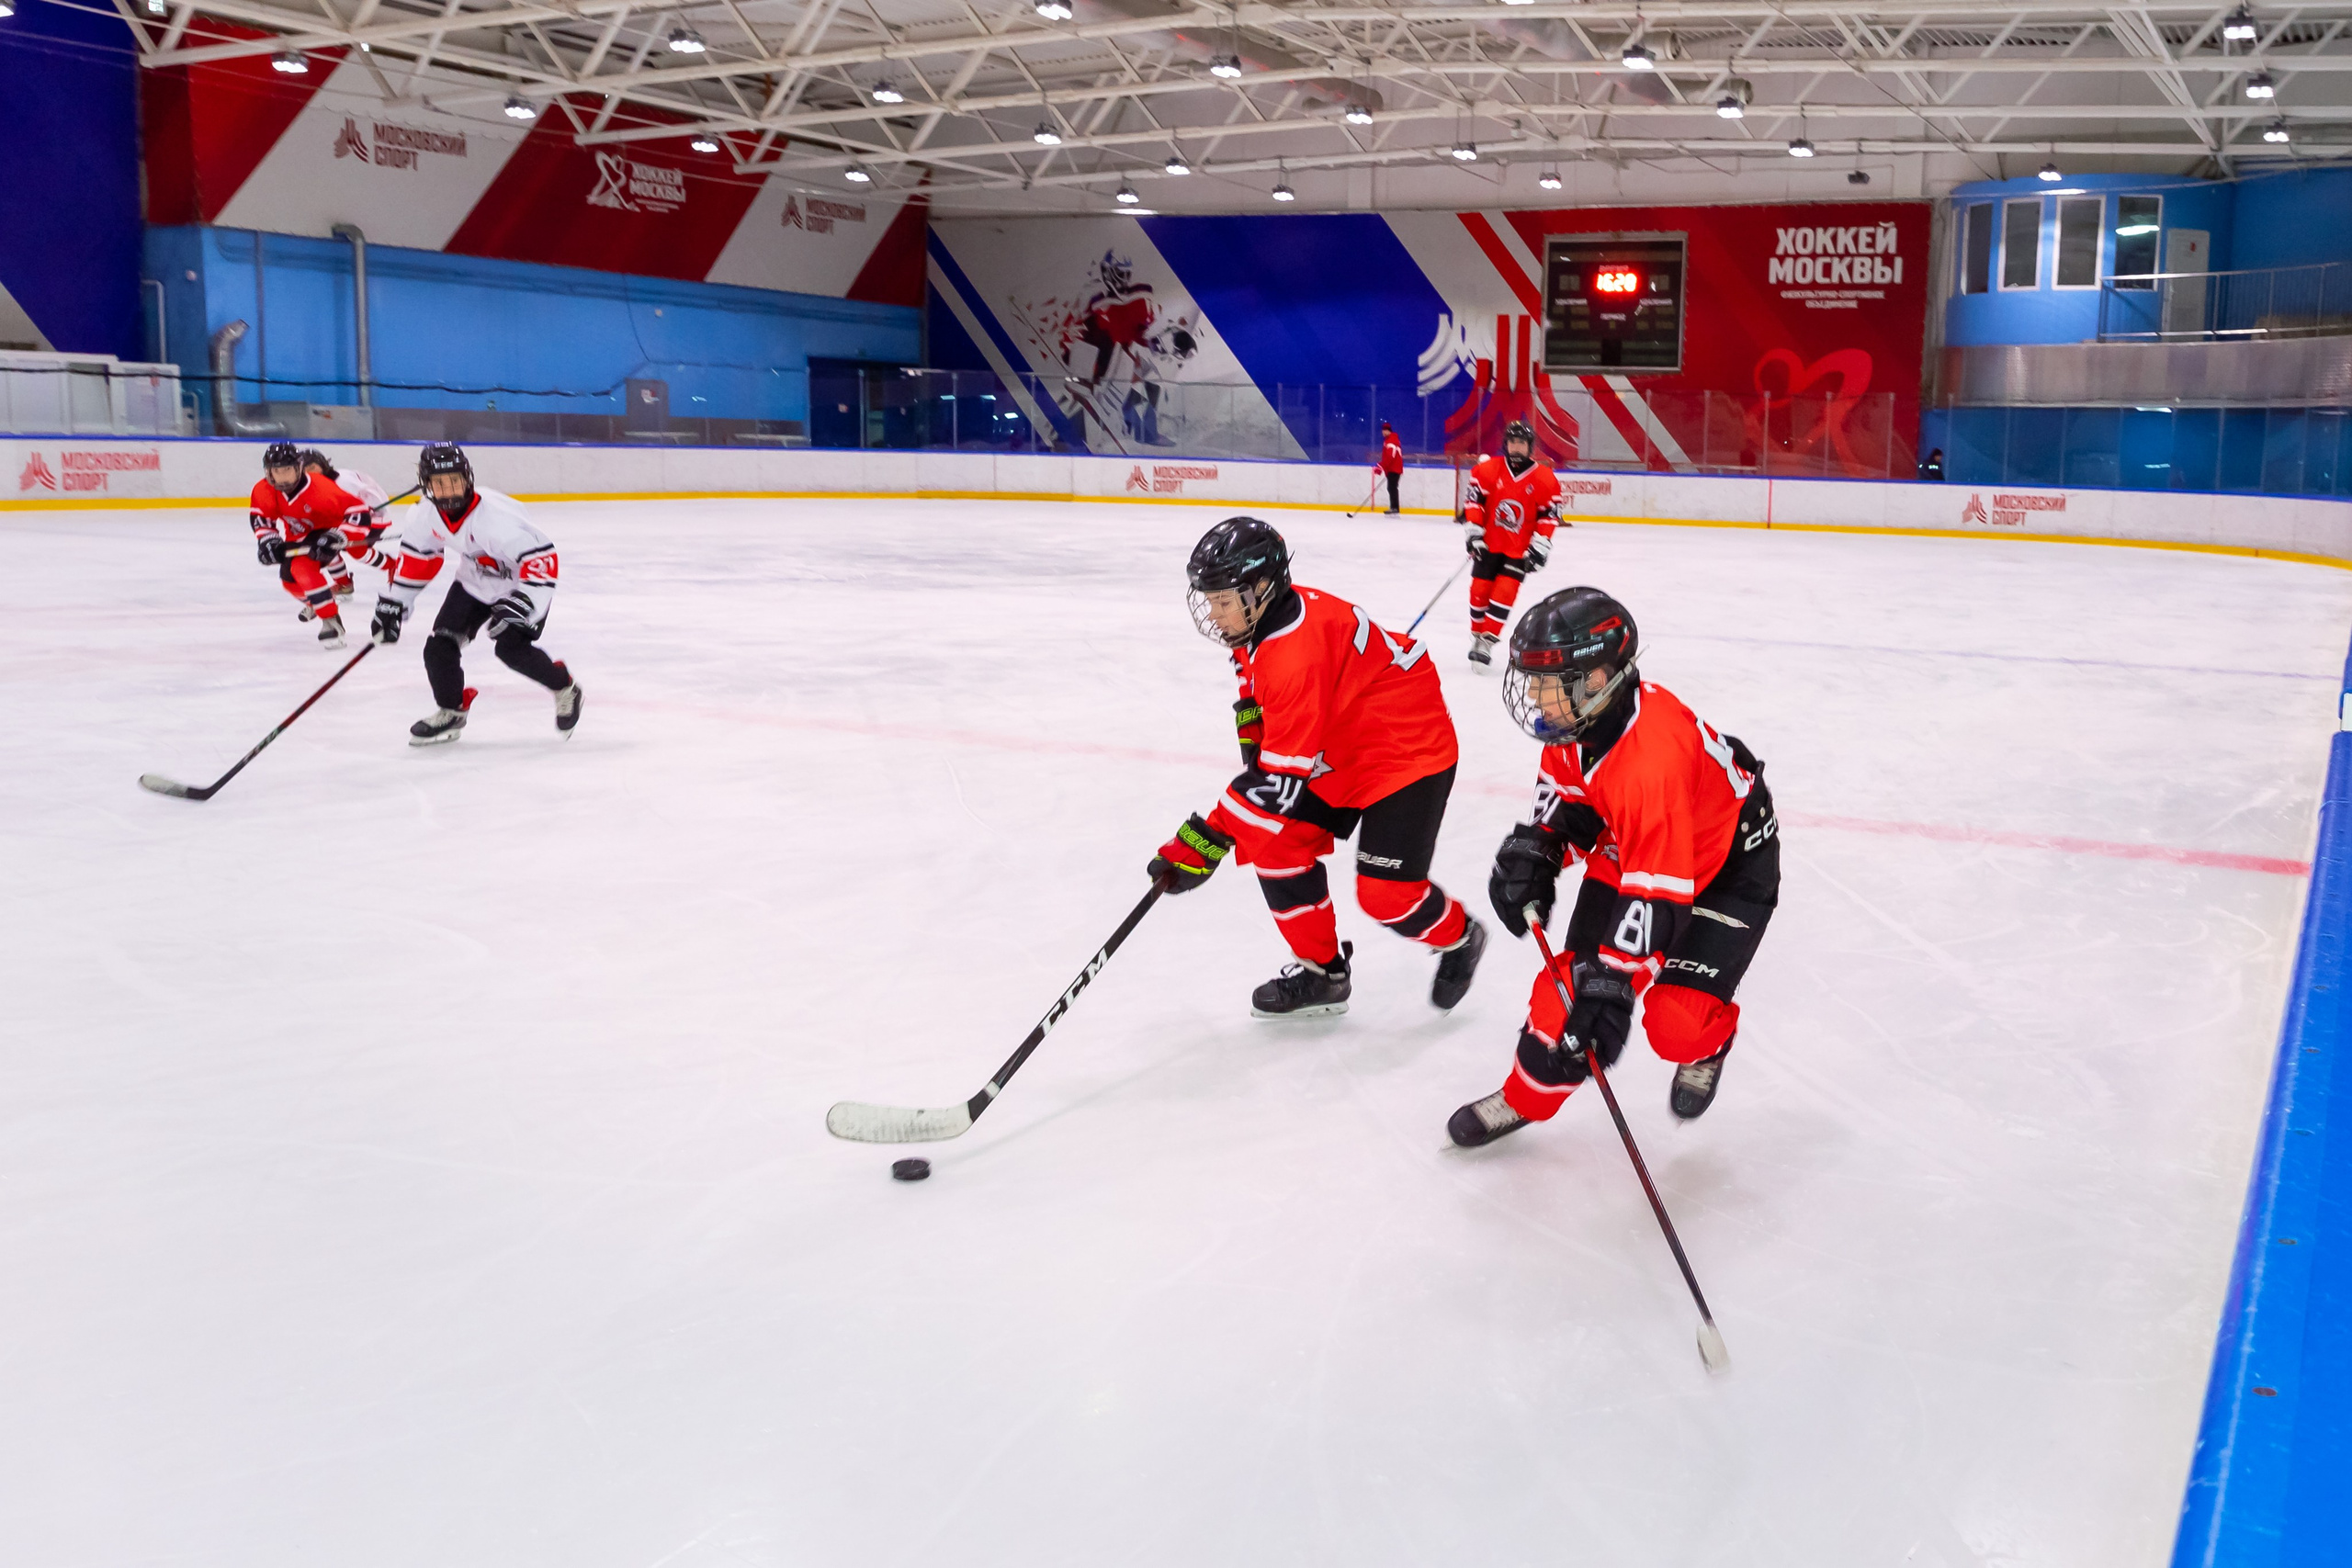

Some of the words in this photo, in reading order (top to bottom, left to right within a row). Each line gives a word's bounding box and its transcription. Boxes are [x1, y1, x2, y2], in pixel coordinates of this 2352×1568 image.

[373, 122, 467, 158] МОСКОВСКИЙ
[374, 144, 419, 171] СПОРТ
[1775, 220, 1898, 255] ХОККЕЙ
[1769, 256, 1904, 285] МОСКВЫ
[61, 448, 160, 471] МОСКОВСКИЙ
[1153, 464, 1218, 480] МОСКОВСКИЙ
[62, 472, 108, 491] СПОРТ
[1153, 479, 1183, 493] СПОРТ
[1993, 493, 2065, 512] МОСКОВСКИЙ
[1992, 510, 2027, 525] СПОРТ
[1246, 773, 1303, 815] 24
[1613, 899, 1653, 956] 81
[1664, 958, 1720, 978] CCM
[1040, 947, 1108, 1036] CCM
